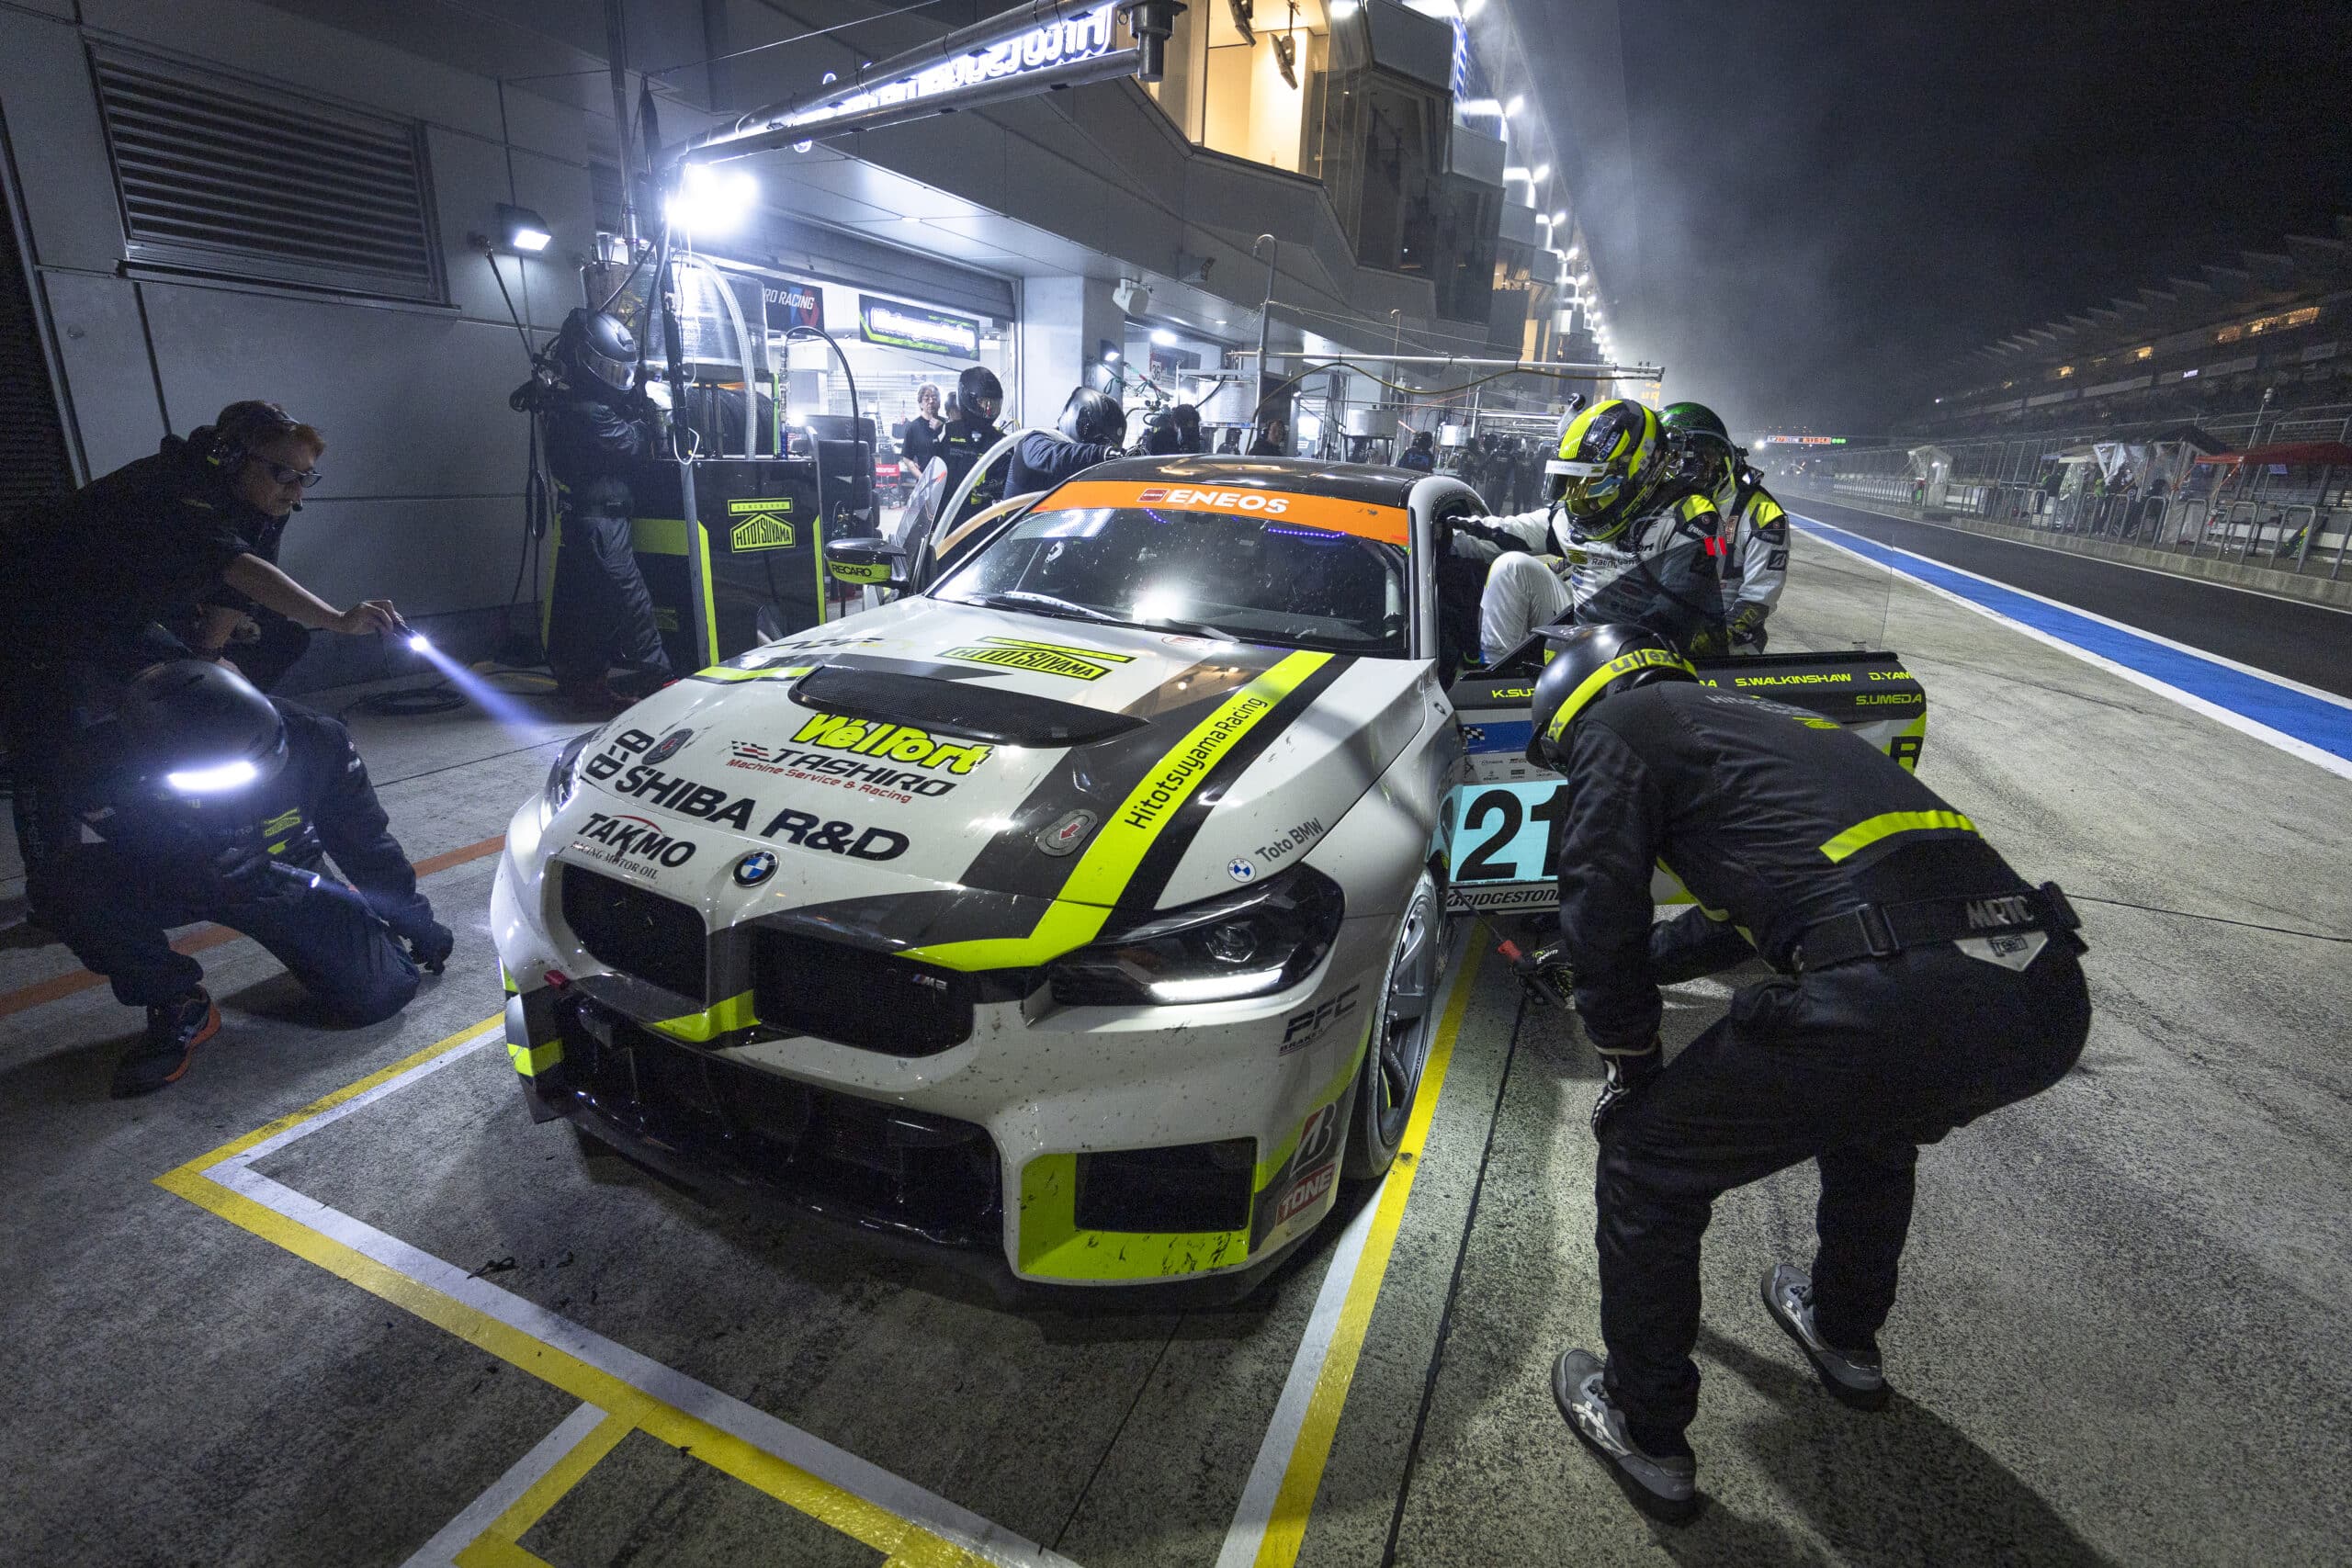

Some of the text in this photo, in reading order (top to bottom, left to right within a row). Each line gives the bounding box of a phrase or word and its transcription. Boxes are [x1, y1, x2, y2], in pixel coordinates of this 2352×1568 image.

[779, 289, 815, 310] RACING
[1166, 490, 1290, 513] ENEOS
[736, 517, 791, 547] HITOTSUYAMA
[831, 563, 872, 578] RECARO
[954, 649, 1095, 677] HITOTSUYAMA
[1491, 687, 1536, 699] K.SU
[1735, 672, 1852, 687] S.WALKINSHAW
[1856, 694, 1922, 705] S.UMEDA
[772, 748, 957, 796] TASHIRO
[1124, 697, 1269, 829] Hitotsuyama Racing
[726, 759, 912, 804] Machine Service & Racing
[615, 765, 910, 862] SHIBA R&D
[1254, 817, 1324, 863] Toto BMW
[1455, 788, 1566, 882] 21
[639, 865, 660, 881] OIL
[1446, 888, 1559, 908] BRIDGESTON
[1283, 984, 1361, 1044] PFC
[1281, 1168, 1332, 1218] TONE
